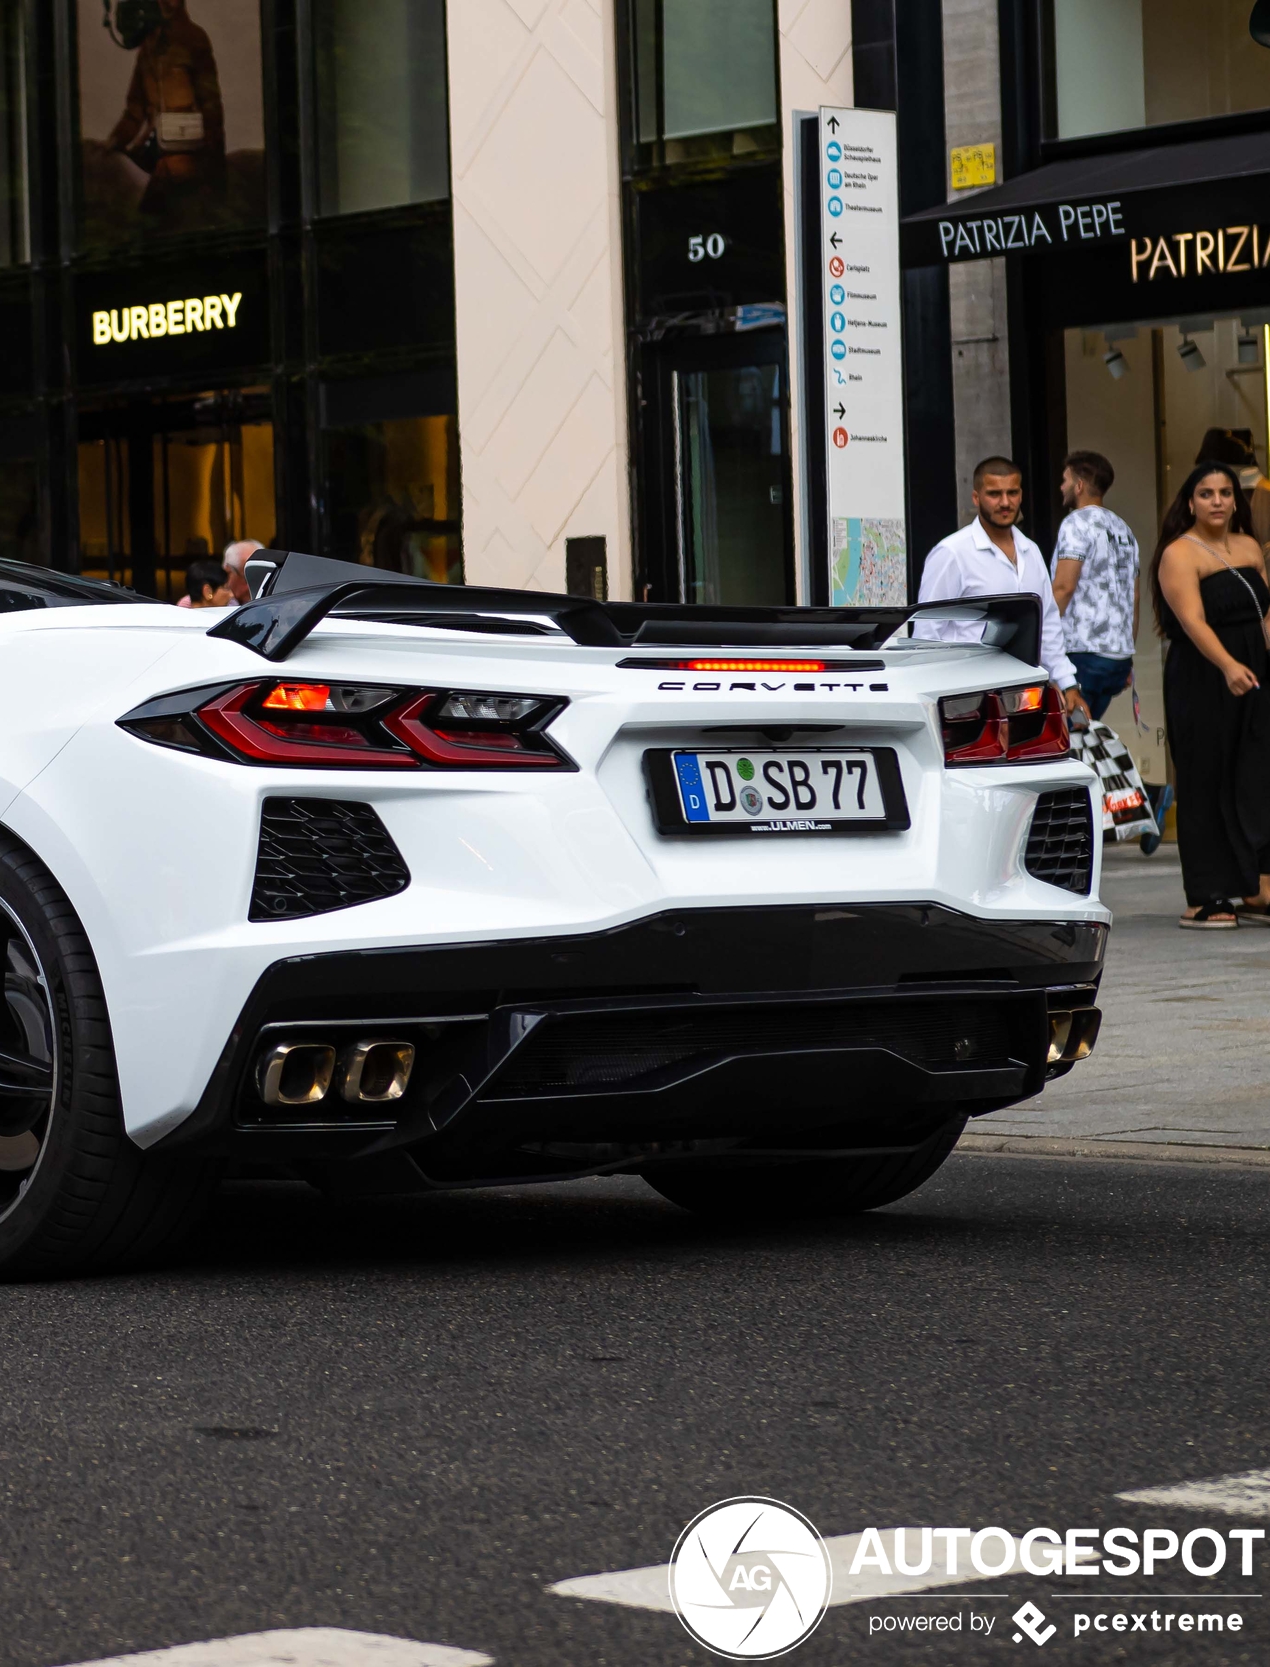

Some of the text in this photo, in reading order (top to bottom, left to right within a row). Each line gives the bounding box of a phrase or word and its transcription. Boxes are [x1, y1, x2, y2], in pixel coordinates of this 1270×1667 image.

[845, 203, 882, 213] Theatermuseum
[938, 201, 1125, 257] PATRIZIA PEPE
[688, 233, 725, 262] 50
[92, 292, 243, 345] BURBERRY
[848, 373, 862, 381] Rhein
[657, 682, 889, 692] CORVETTE
[705, 760, 736, 811] D
[762, 759, 817, 811] SB
[821, 760, 868, 810] 77
[690, 795, 700, 809] D
[750, 820, 832, 832] www.ULMEN.com
[57, 991, 72, 1103] MICHELIN
